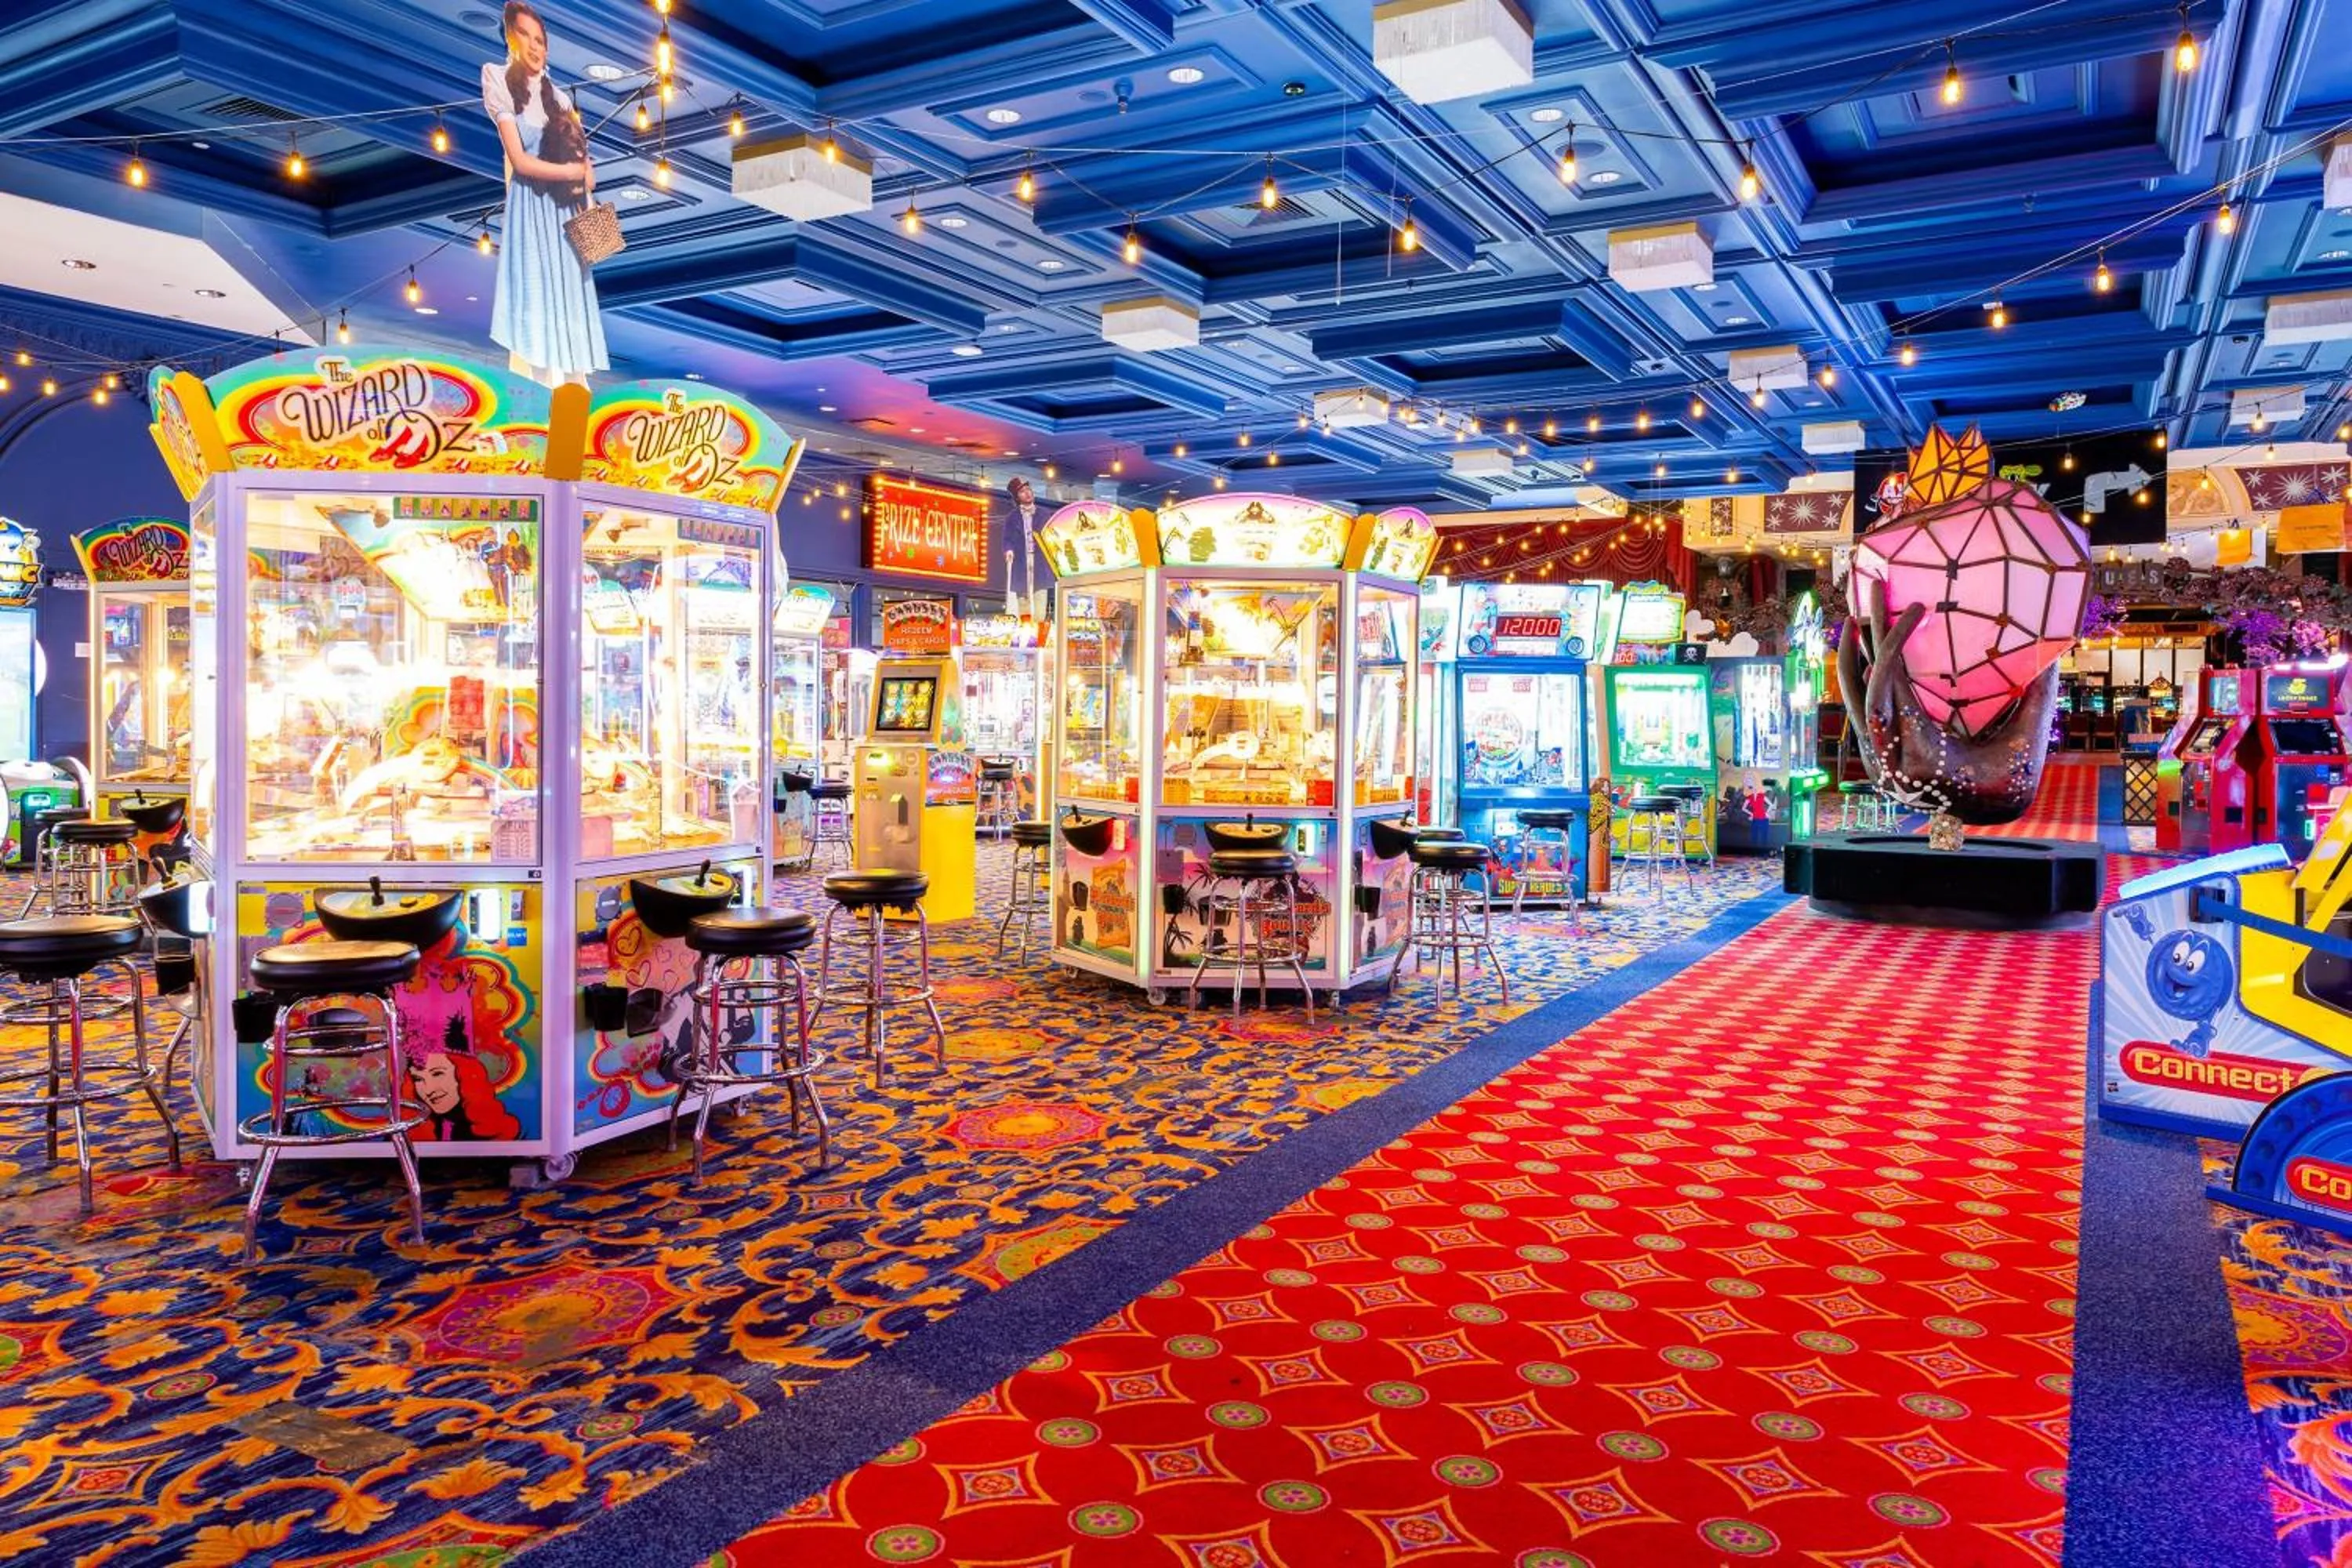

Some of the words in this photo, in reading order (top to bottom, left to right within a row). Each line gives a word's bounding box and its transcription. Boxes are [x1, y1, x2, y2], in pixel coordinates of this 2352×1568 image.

[321, 361, 353, 383] The
[281, 363, 427, 442] WIZARD
[667, 393, 684, 414] The
[366, 418, 386, 441] of
[880, 502, 921, 552] PRIZE
[924, 508, 978, 562] CENTER
[1502, 618, 1561, 636] 12000
[2133, 1051, 2296, 1094] Connect
